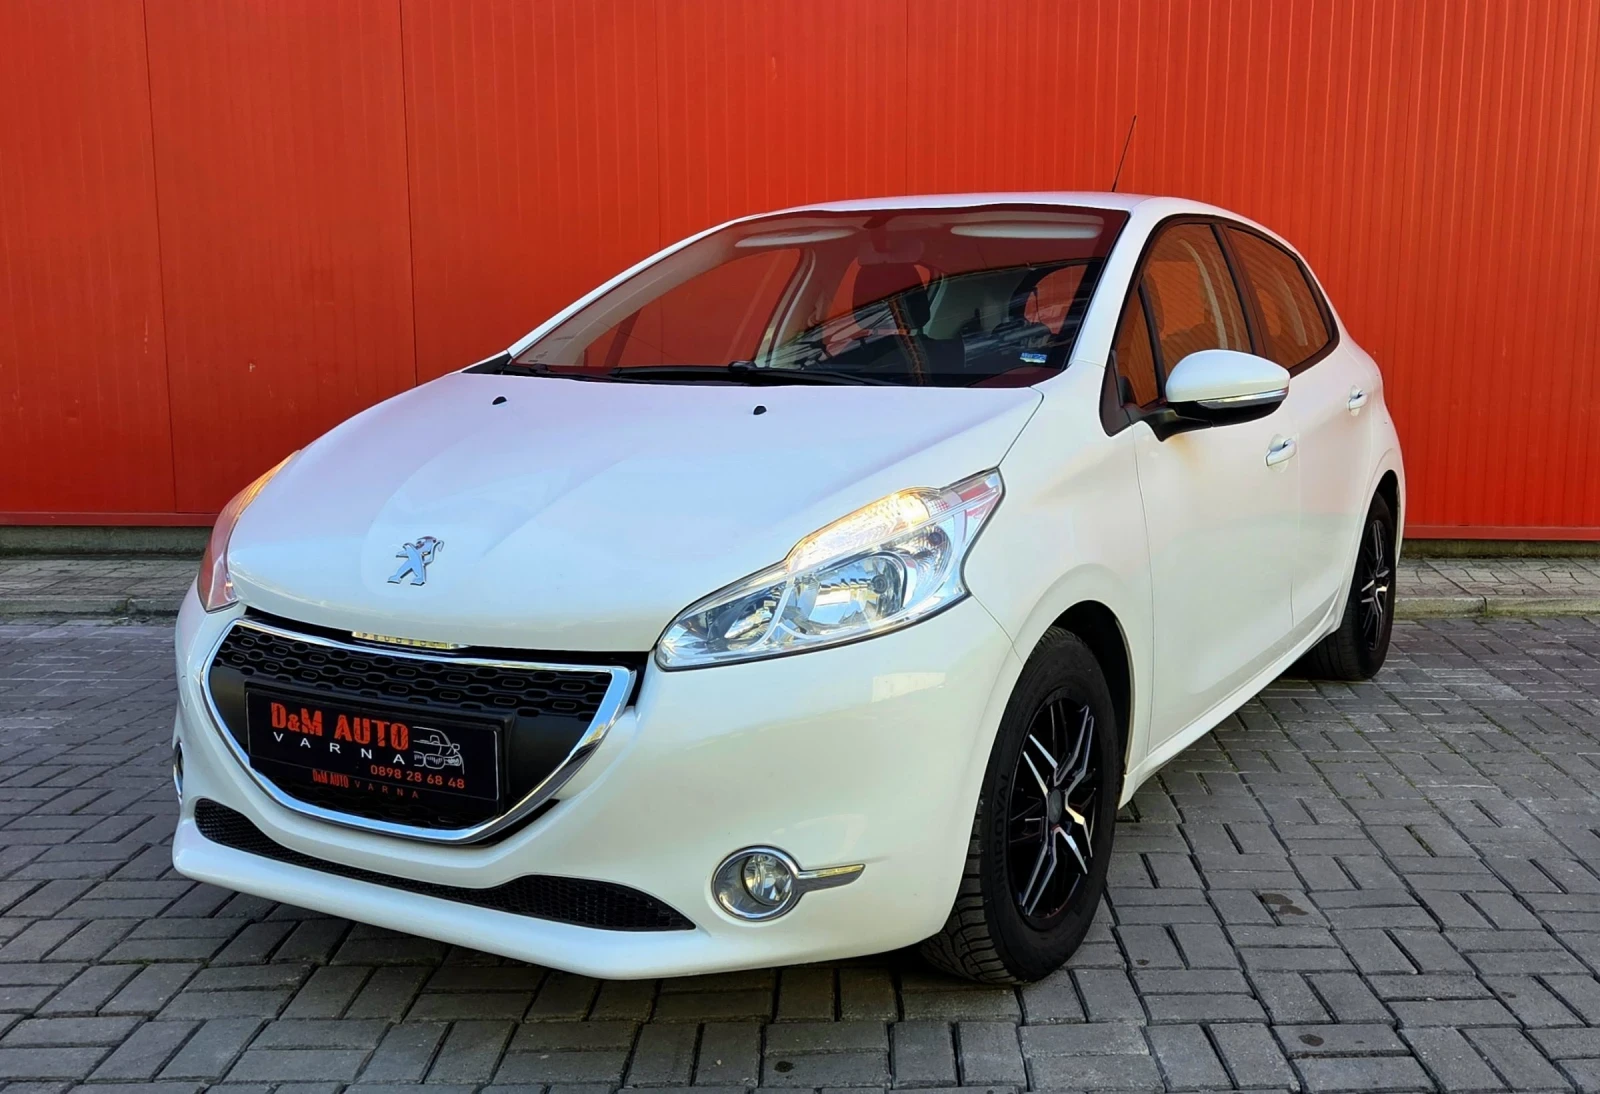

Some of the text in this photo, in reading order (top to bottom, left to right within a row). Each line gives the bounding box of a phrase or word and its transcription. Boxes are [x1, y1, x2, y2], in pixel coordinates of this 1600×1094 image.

[270, 702, 409, 750] D&M AUTO
[273, 732, 405, 765] VARNA
[329, 771, 349, 788] AUTO
[355, 780, 419, 799] VARNA
[370, 764, 465, 789] 0898 28 68 48
